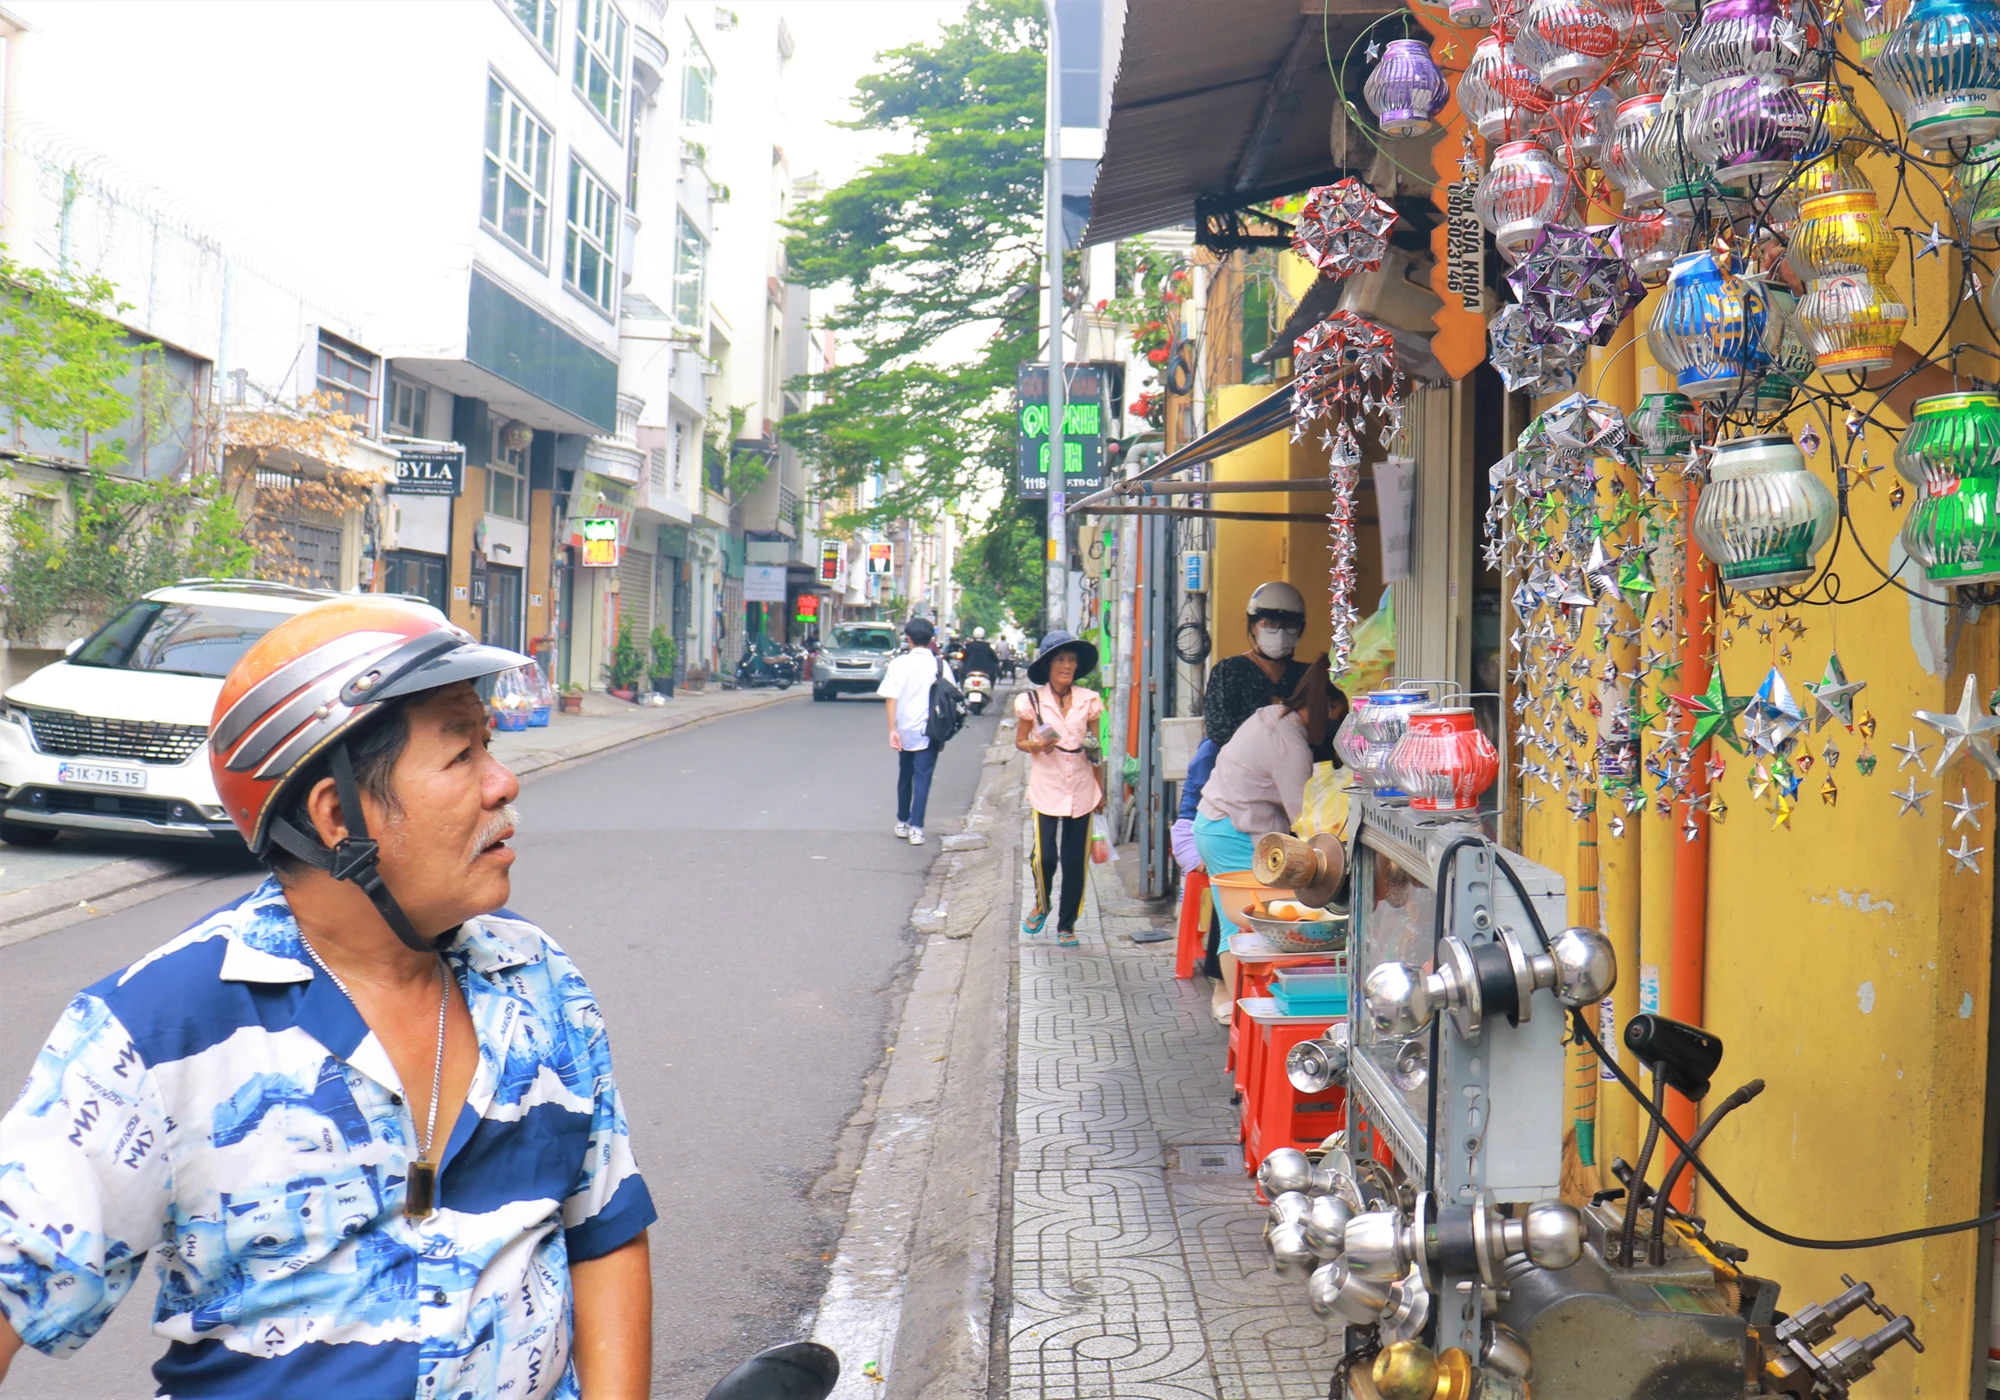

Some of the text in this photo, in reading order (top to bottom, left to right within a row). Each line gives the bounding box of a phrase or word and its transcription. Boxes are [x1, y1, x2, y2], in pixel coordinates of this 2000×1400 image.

[1447, 184, 1462, 291] 0903023146
[1462, 218, 1483, 254] SỬA
[1462, 260, 1483, 308] KHÓA
[396, 461, 454, 480] BYLA
[1024, 477, 1047, 490] 111B
